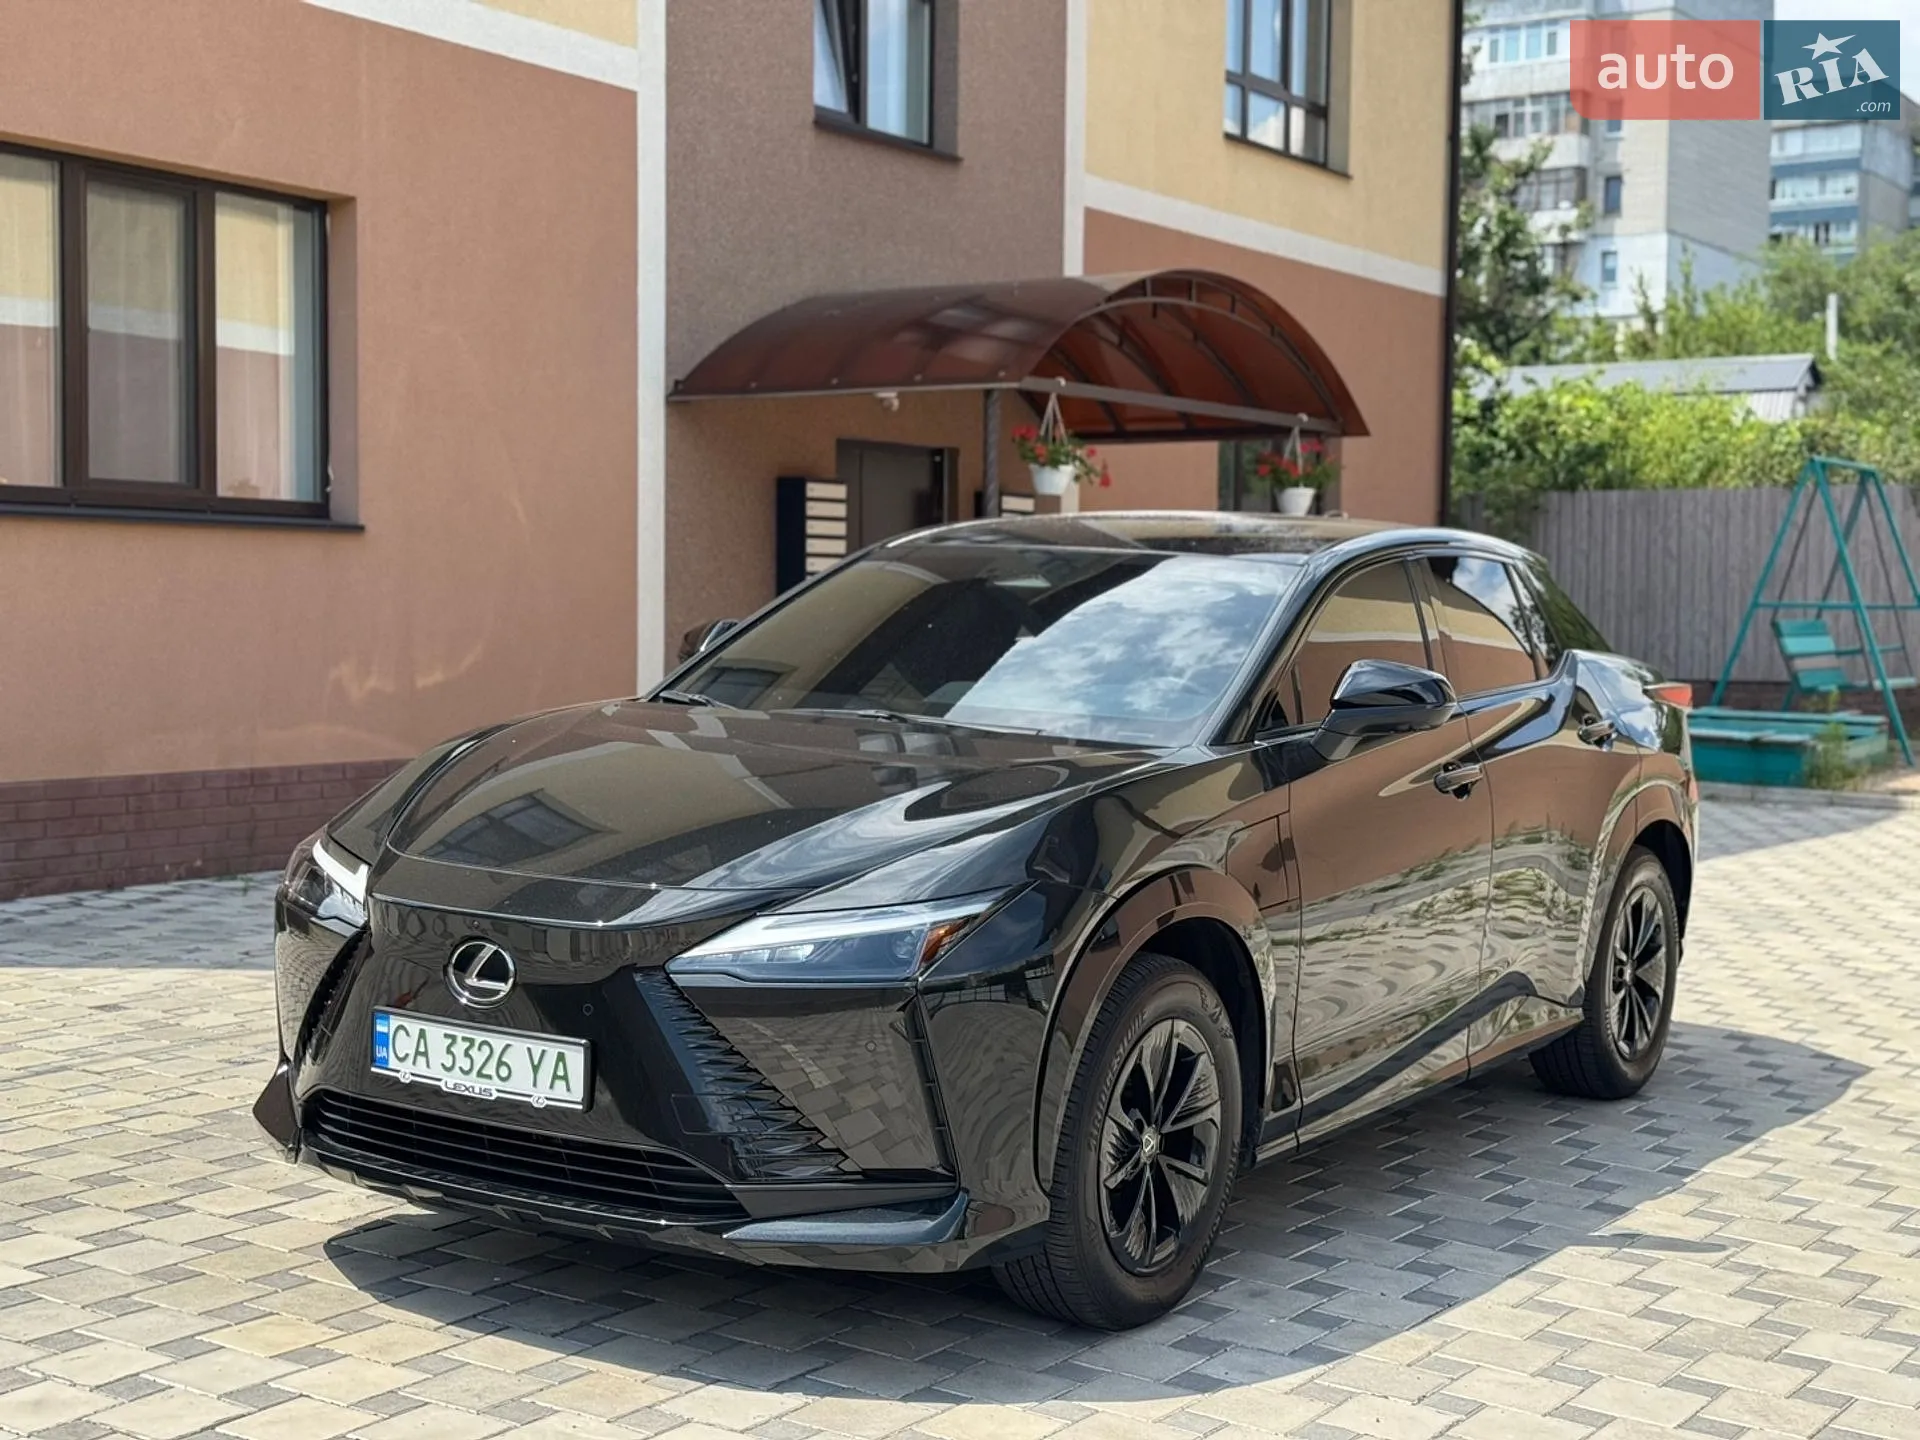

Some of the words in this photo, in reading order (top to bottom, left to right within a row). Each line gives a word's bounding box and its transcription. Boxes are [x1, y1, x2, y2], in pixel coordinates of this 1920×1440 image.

[391, 1023, 432, 1070] CA
[440, 1032, 513, 1083] 3326
[526, 1045, 572, 1093] YA
[443, 1080, 494, 1099] LEXUS
